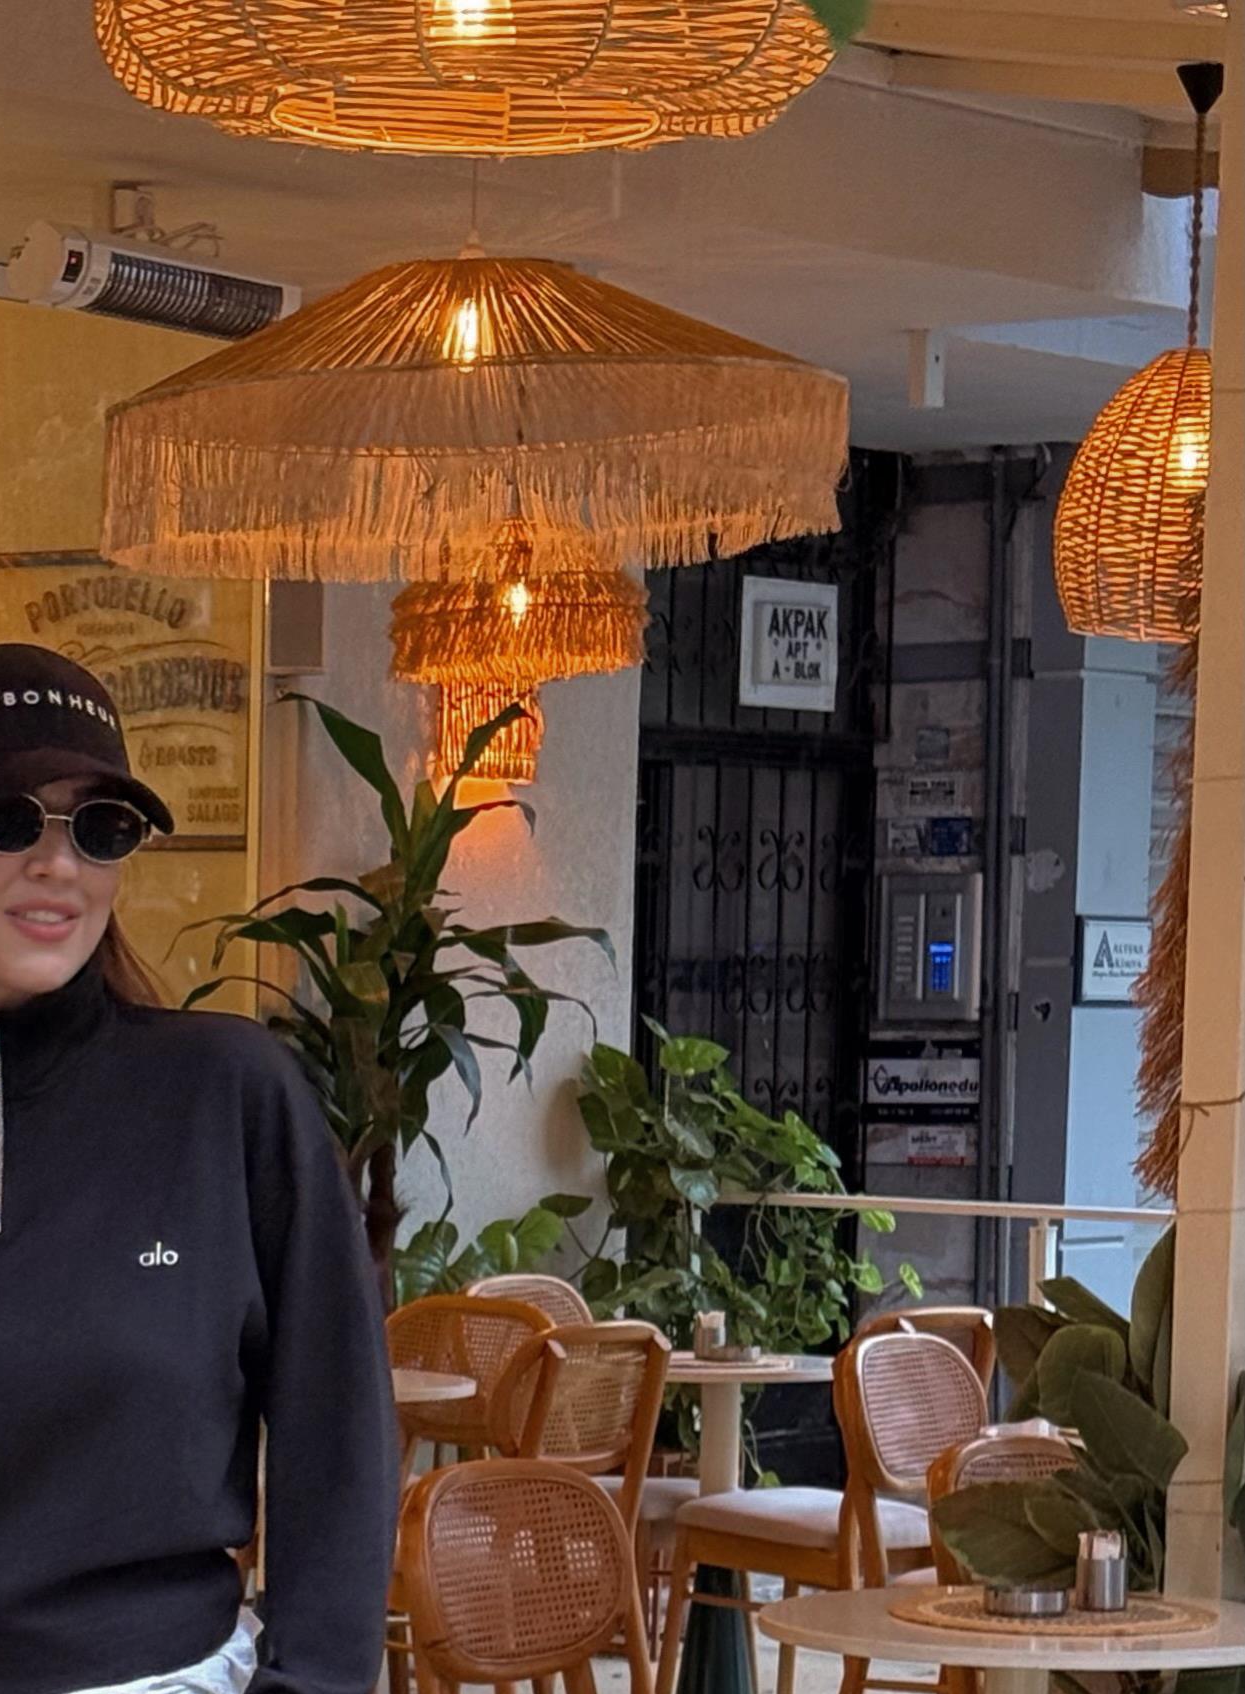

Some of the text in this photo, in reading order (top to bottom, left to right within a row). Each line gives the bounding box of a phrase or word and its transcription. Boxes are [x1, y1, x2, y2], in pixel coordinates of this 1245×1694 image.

[24, 575, 187, 634] PORTOBELLO
[768, 608, 828, 640] AKPAK
[786, 641, 809, 660] APT
[772, 659, 781, 680] A
[794, 661, 821, 680] BLOK
[138, 1240, 179, 1267] alo
